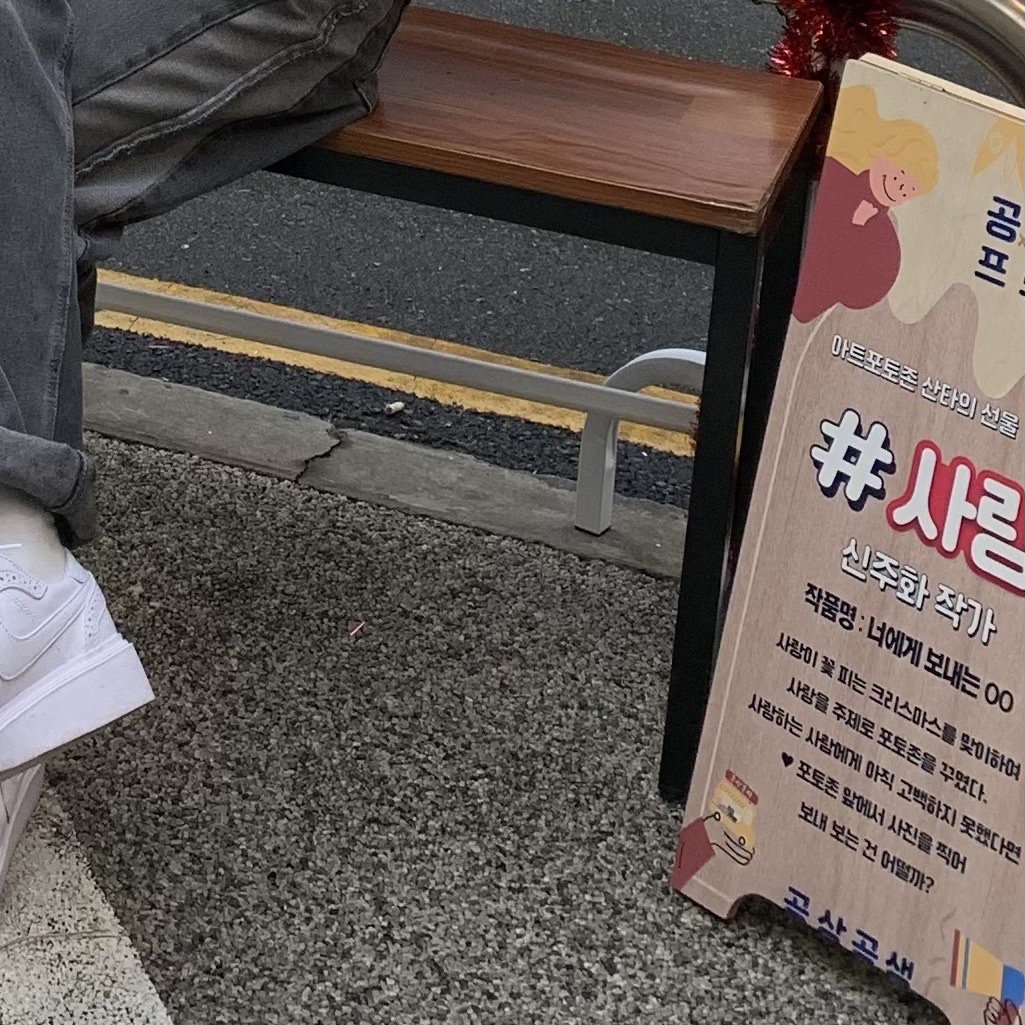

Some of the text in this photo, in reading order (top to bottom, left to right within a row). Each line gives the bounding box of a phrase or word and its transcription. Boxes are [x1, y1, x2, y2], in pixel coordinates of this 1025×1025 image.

[831, 334, 1020, 439] 아트포토존 산타의 선물
[804, 582, 858, 631] 작품명
[866, 615, 924, 668] 너에게
[924, 647, 981, 700] 보내는
[841, 537, 998, 646] 신주화 작가
[776, 631, 1022, 782] 사랑이 꽃 피는 크리스마스를 맞이하여
[786, 677, 988, 805] 사랑을 주제로 포토존을 꾸몄다.
[748, 693, 1022, 866] 사랑하는 사람에게 아직 고백하지 못했다면
[796, 759, 839, 800] 포토존
[841, 786, 886, 827] 앞에서
[887, 815, 933, 856] 사진을
[935, 840, 967, 875] 찍어
[798, 801, 935, 894] 보내 보는 건 어떨까?
